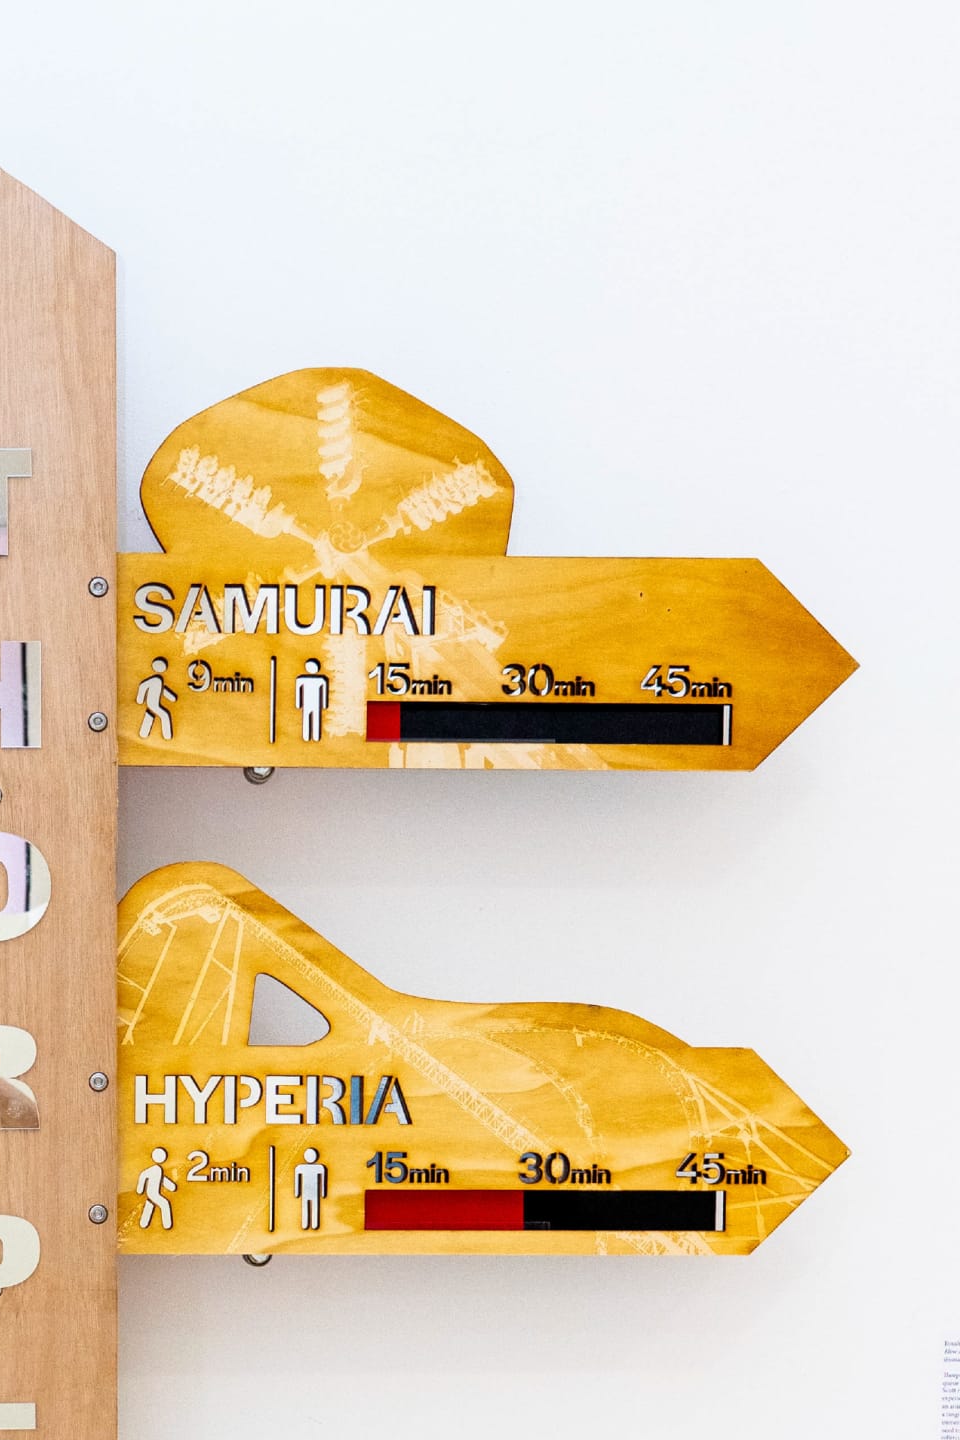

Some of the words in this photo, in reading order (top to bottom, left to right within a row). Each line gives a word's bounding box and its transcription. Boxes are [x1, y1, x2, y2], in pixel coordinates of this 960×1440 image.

[133, 583, 436, 636] SAMURAI
[186, 659, 254, 694] 9min
[368, 662, 453, 697] 15min
[501, 662, 595, 698] 30min
[641, 664, 733, 698] 45min
[134, 1074, 413, 1125] HYPERIA
[185, 1150, 251, 1183] 2min
[366, 1151, 450, 1184] 15min
[517, 1151, 611, 1185] 30min
[675, 1151, 767, 1185] 45min
